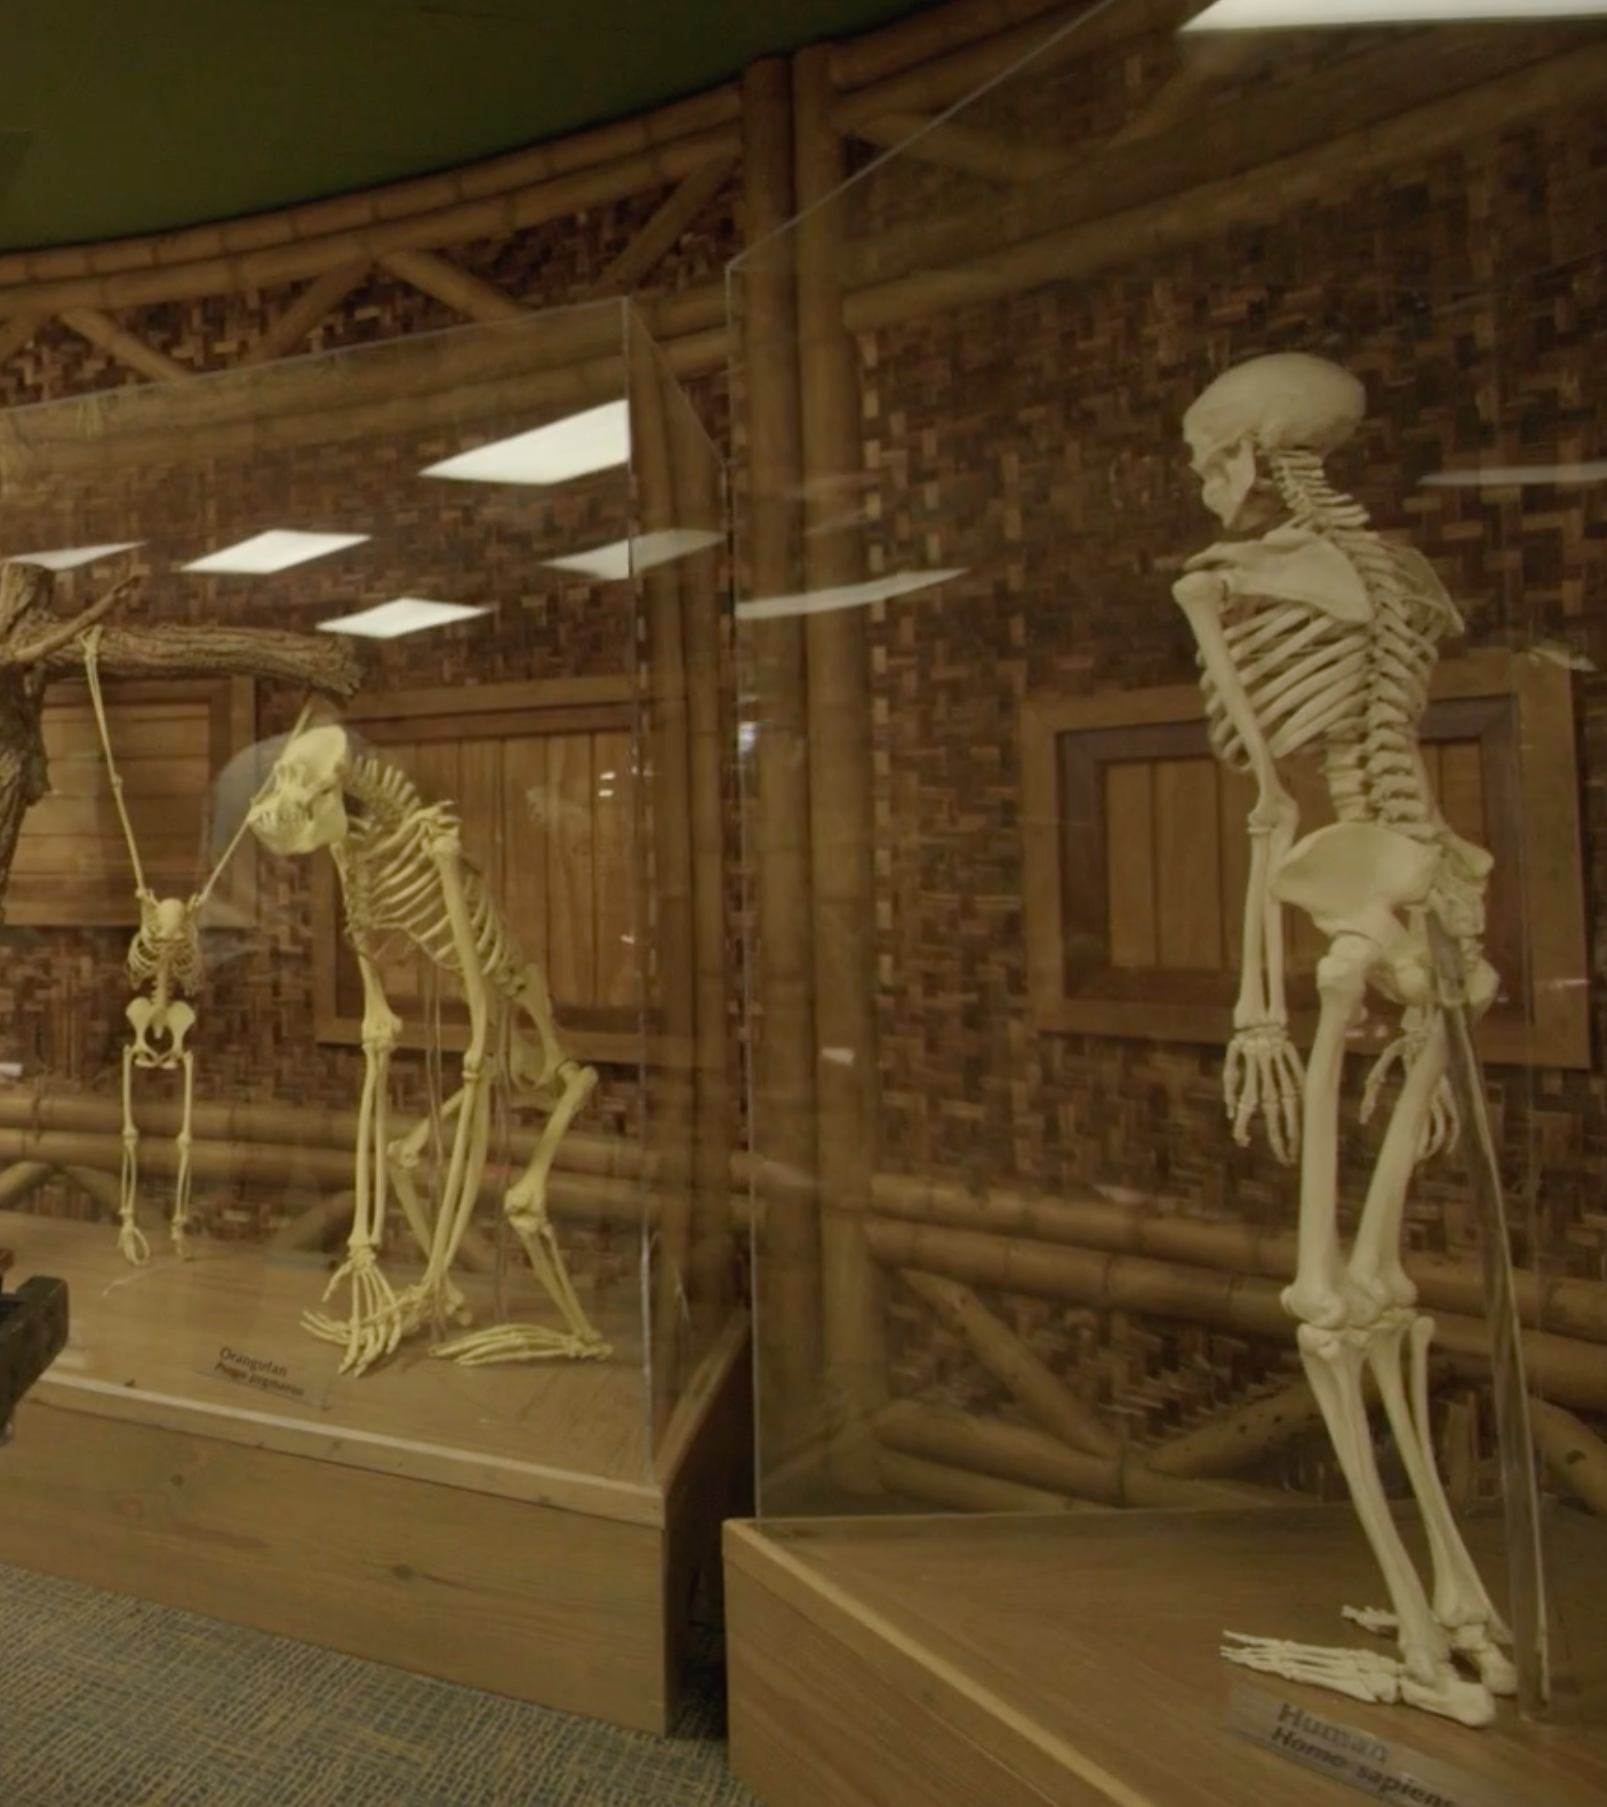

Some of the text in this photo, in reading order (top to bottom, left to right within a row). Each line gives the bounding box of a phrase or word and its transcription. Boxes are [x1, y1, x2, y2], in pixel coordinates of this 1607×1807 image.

[219, 1346, 288, 1378] Orangutan
[1271, 1726, 1348, 1768] Homo
[1278, 1703, 1388, 1765] Human
